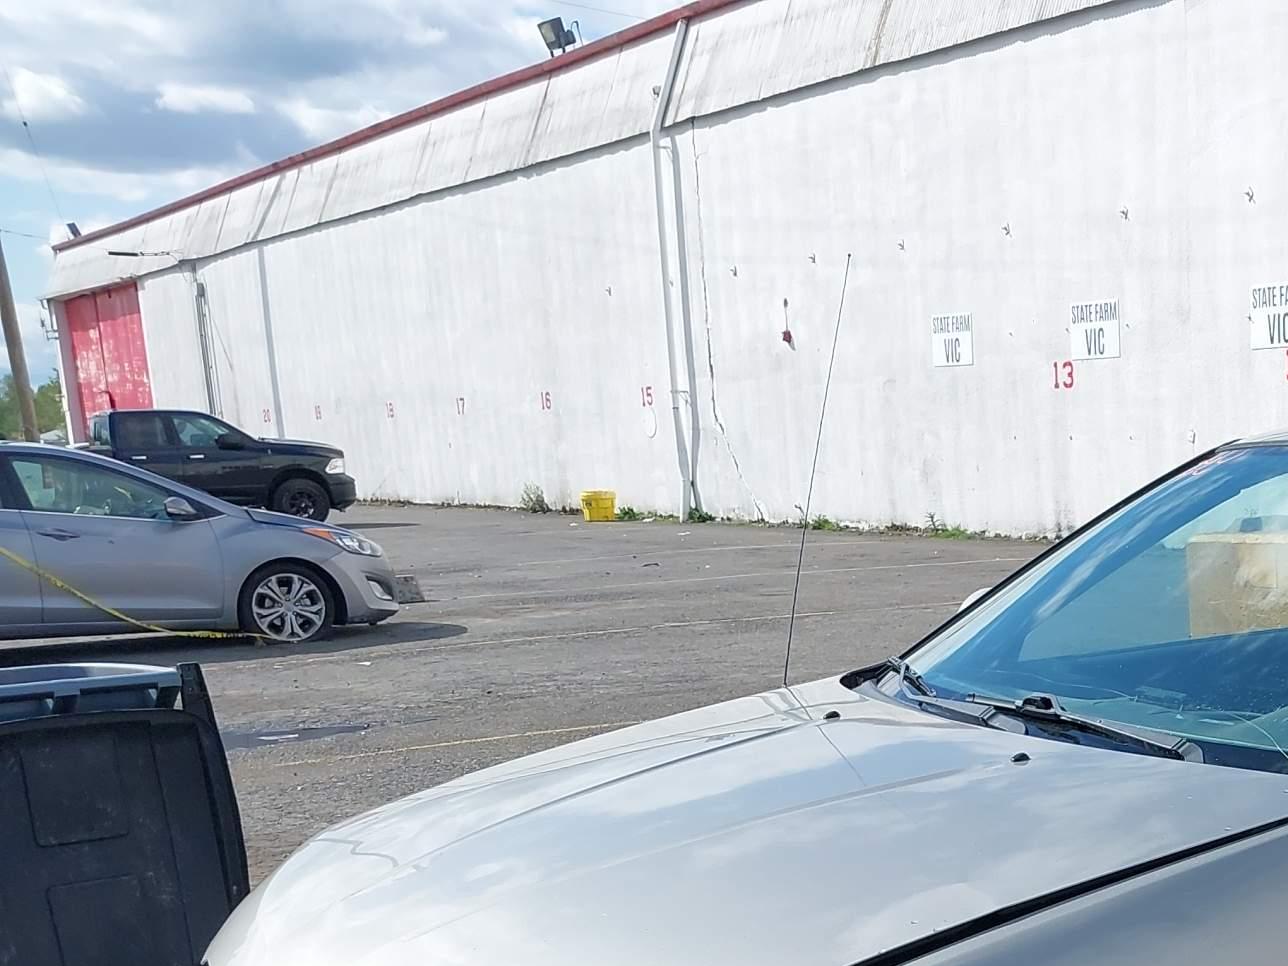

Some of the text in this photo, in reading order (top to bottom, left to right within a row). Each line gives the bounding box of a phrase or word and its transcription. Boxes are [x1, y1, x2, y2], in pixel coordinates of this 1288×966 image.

[1252, 286, 1277, 309] STATE
[932, 313, 971, 335] STATE FARM
[1071, 300, 1118, 325] STATE FARM
[943, 337, 961, 364] VIC
[1085, 327, 1105, 356] VIC
[1053, 361, 1074, 389] 13
[455, 397, 465, 416] 17
[540, 391, 552, 411] 16
[641, 386, 654, 408] 15
